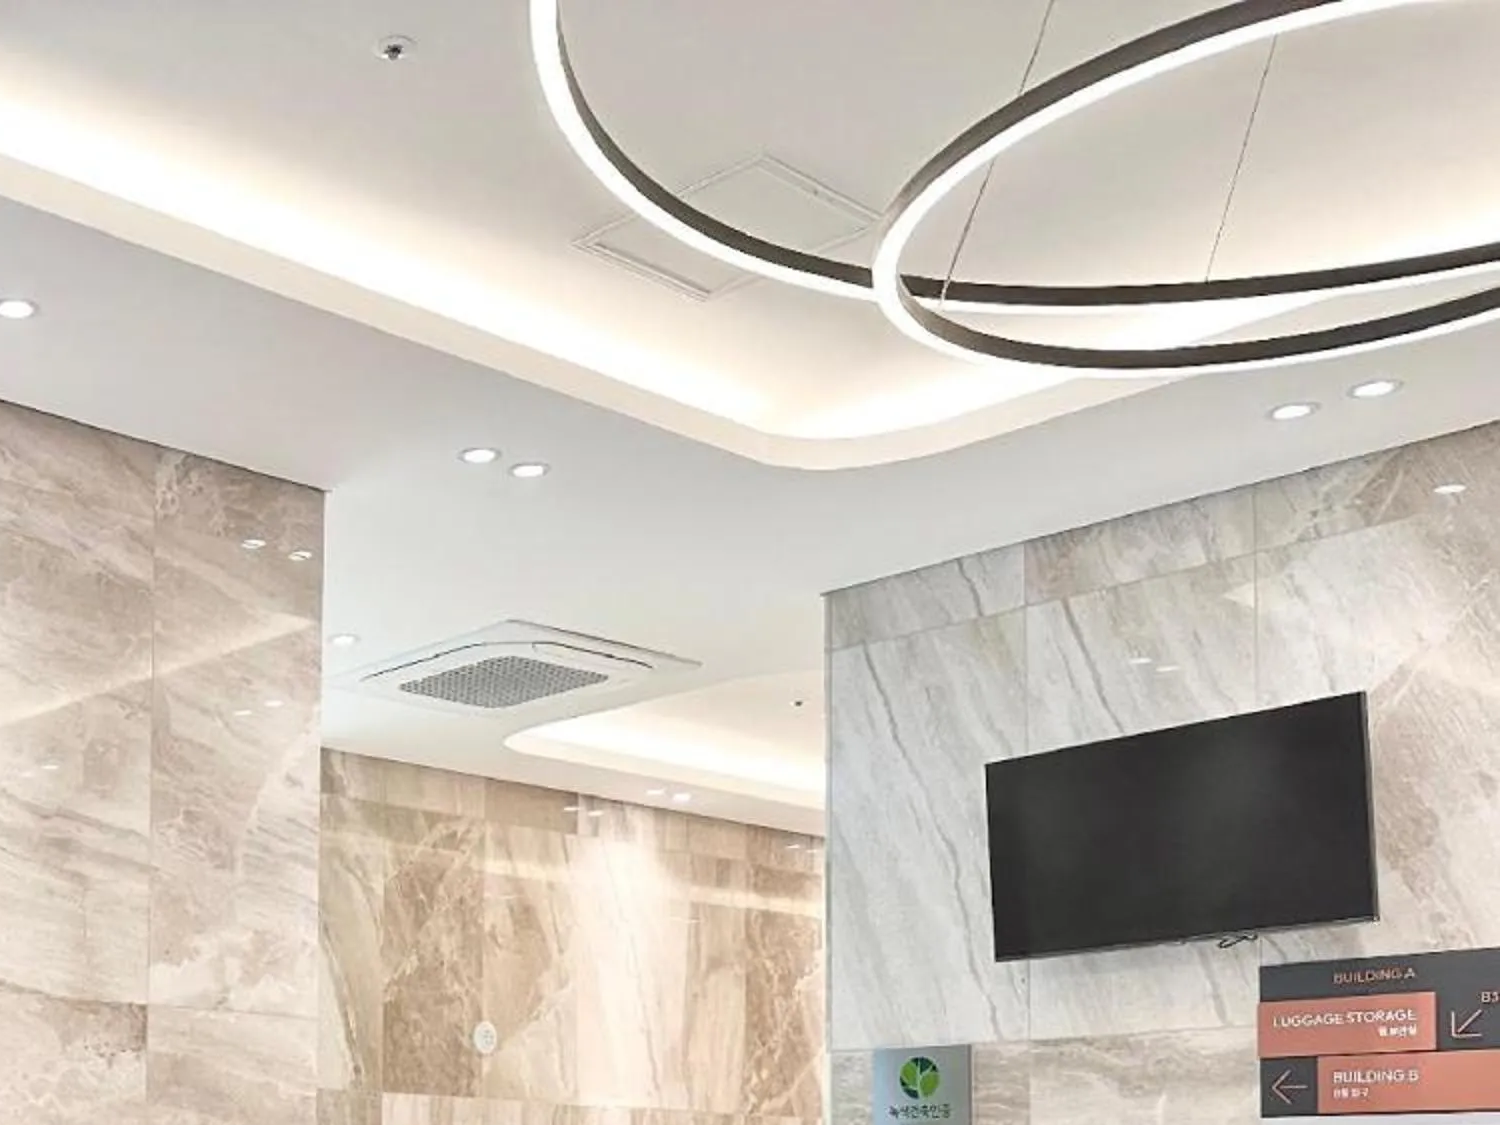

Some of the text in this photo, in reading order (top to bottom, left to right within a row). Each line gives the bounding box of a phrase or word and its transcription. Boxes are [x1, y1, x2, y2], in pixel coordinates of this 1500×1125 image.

[1333, 967, 1417, 985] BUILDING A
[1273, 1008, 1418, 1029] LUGGAGE STORAGE
[1332, 1070, 1405, 1084] BUILDING
